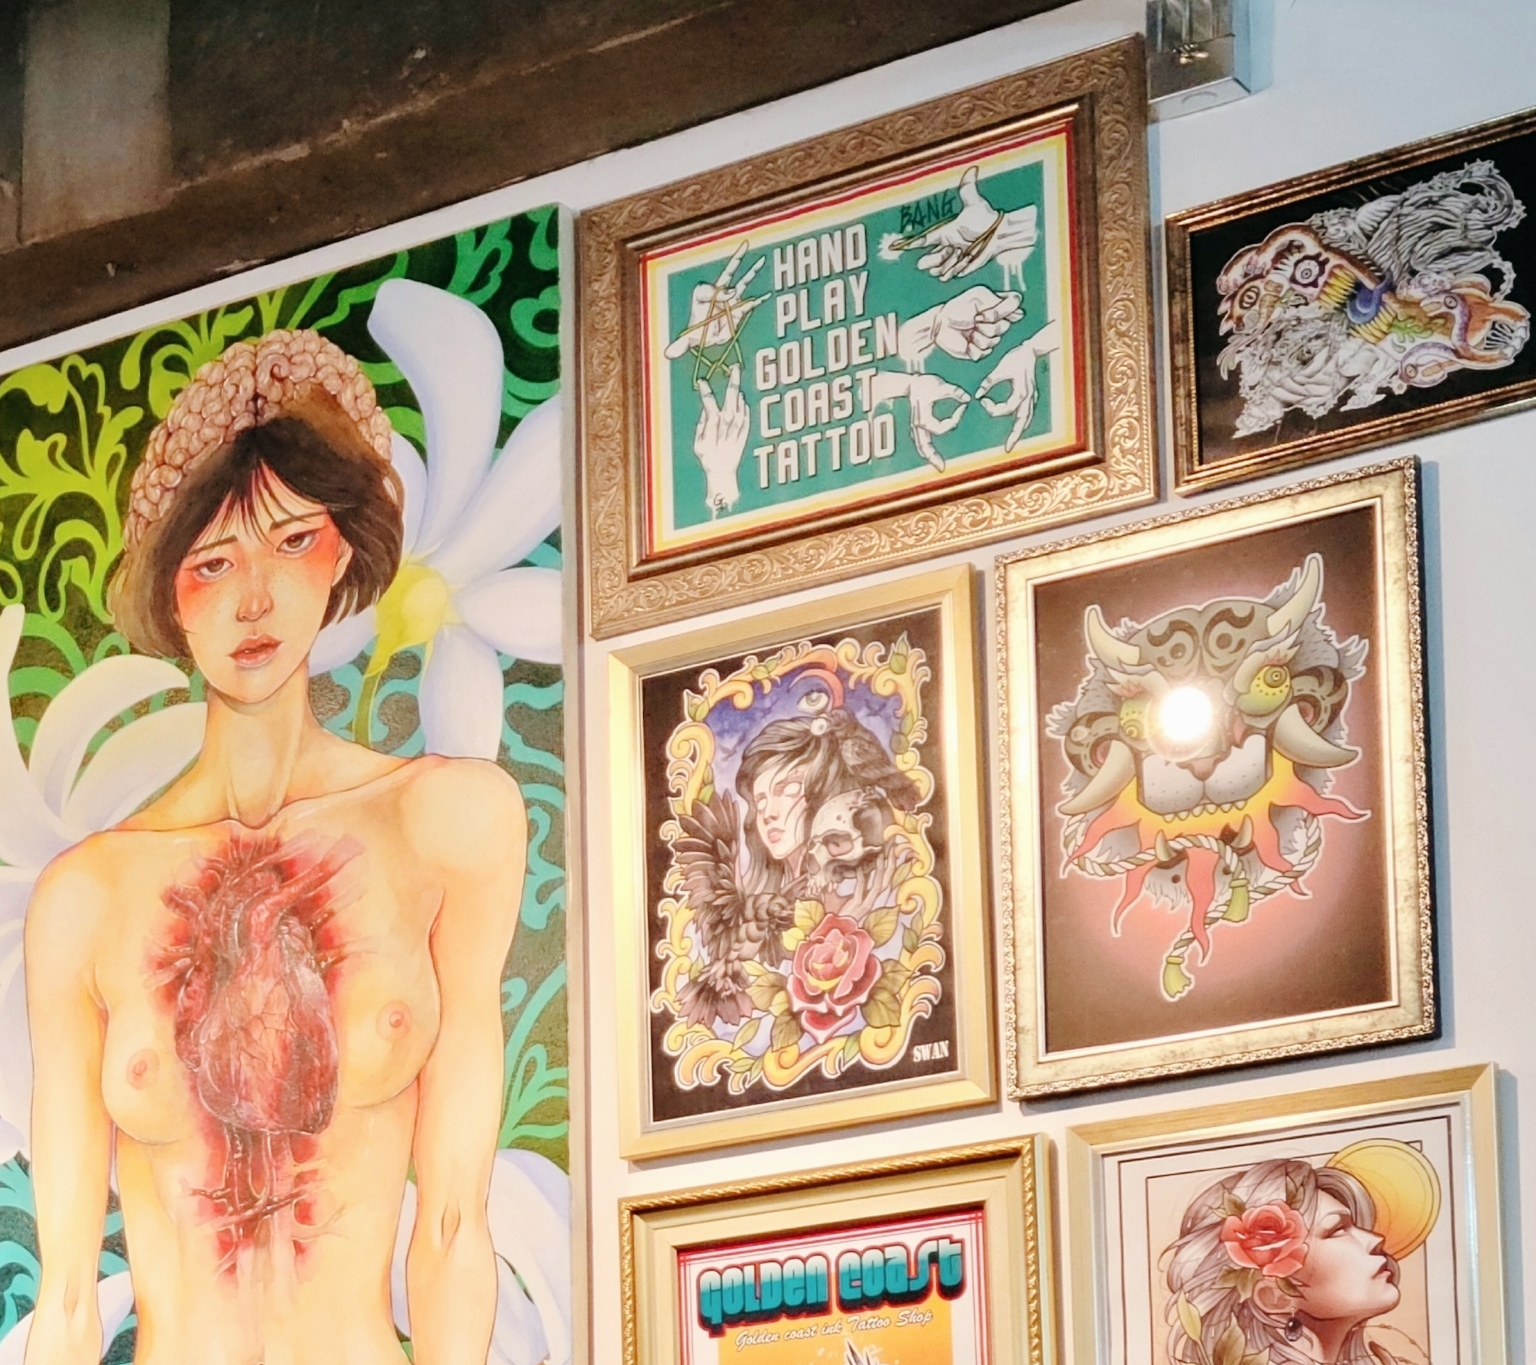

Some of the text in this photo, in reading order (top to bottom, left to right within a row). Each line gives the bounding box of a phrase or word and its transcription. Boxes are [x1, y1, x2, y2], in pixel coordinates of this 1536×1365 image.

[900, 188, 956, 233] BANG
[773, 223, 867, 290] HAND
[776, 271, 869, 338] PLAY
[755, 312, 898, 391] GOLDEN
[760, 367, 877, 439] COAST
[753, 413, 896, 489] TATTOO
[913, 1040, 950, 1062] SWAN
[735, 1309, 933, 1351] Golden coast ink Tattoo Shop
